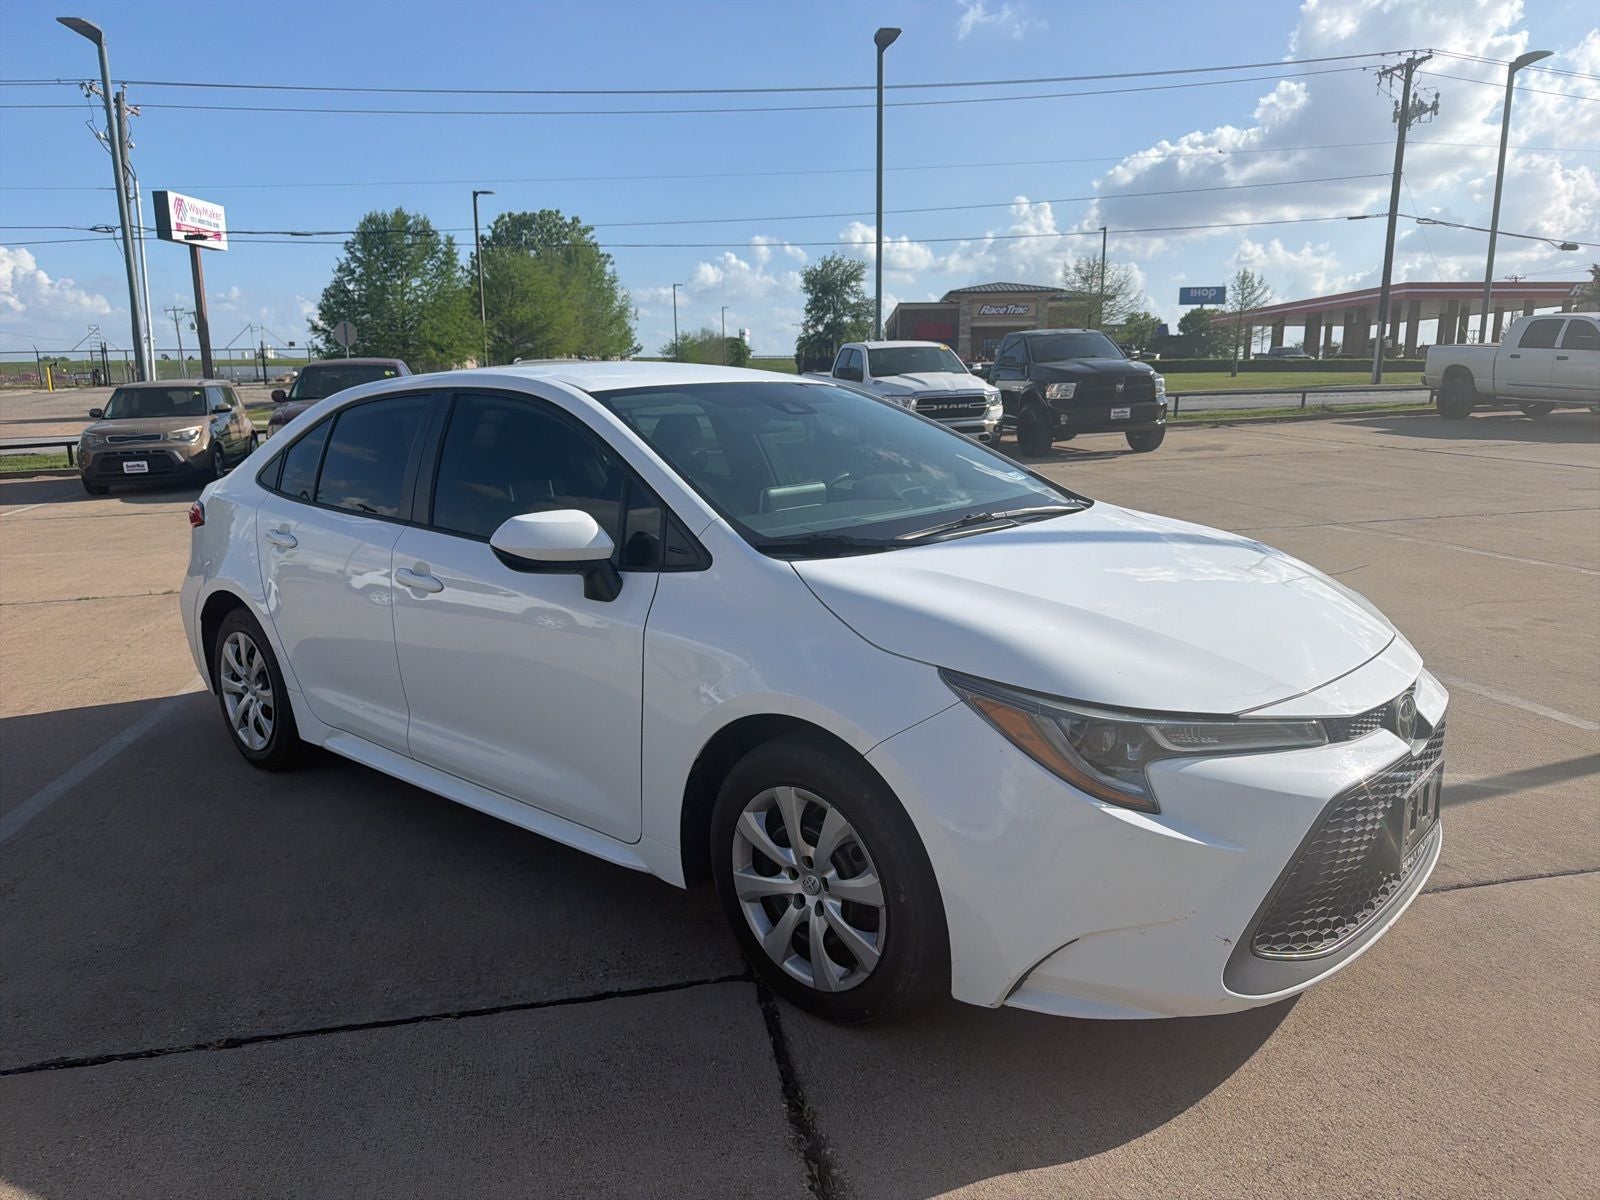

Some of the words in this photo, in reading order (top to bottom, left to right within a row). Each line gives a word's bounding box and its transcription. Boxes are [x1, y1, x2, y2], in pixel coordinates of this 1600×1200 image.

[187, 201, 222, 220] WayMaker
[1190, 288, 1217, 299] IHOP
[979, 303, 1029, 315] RaceTrac
